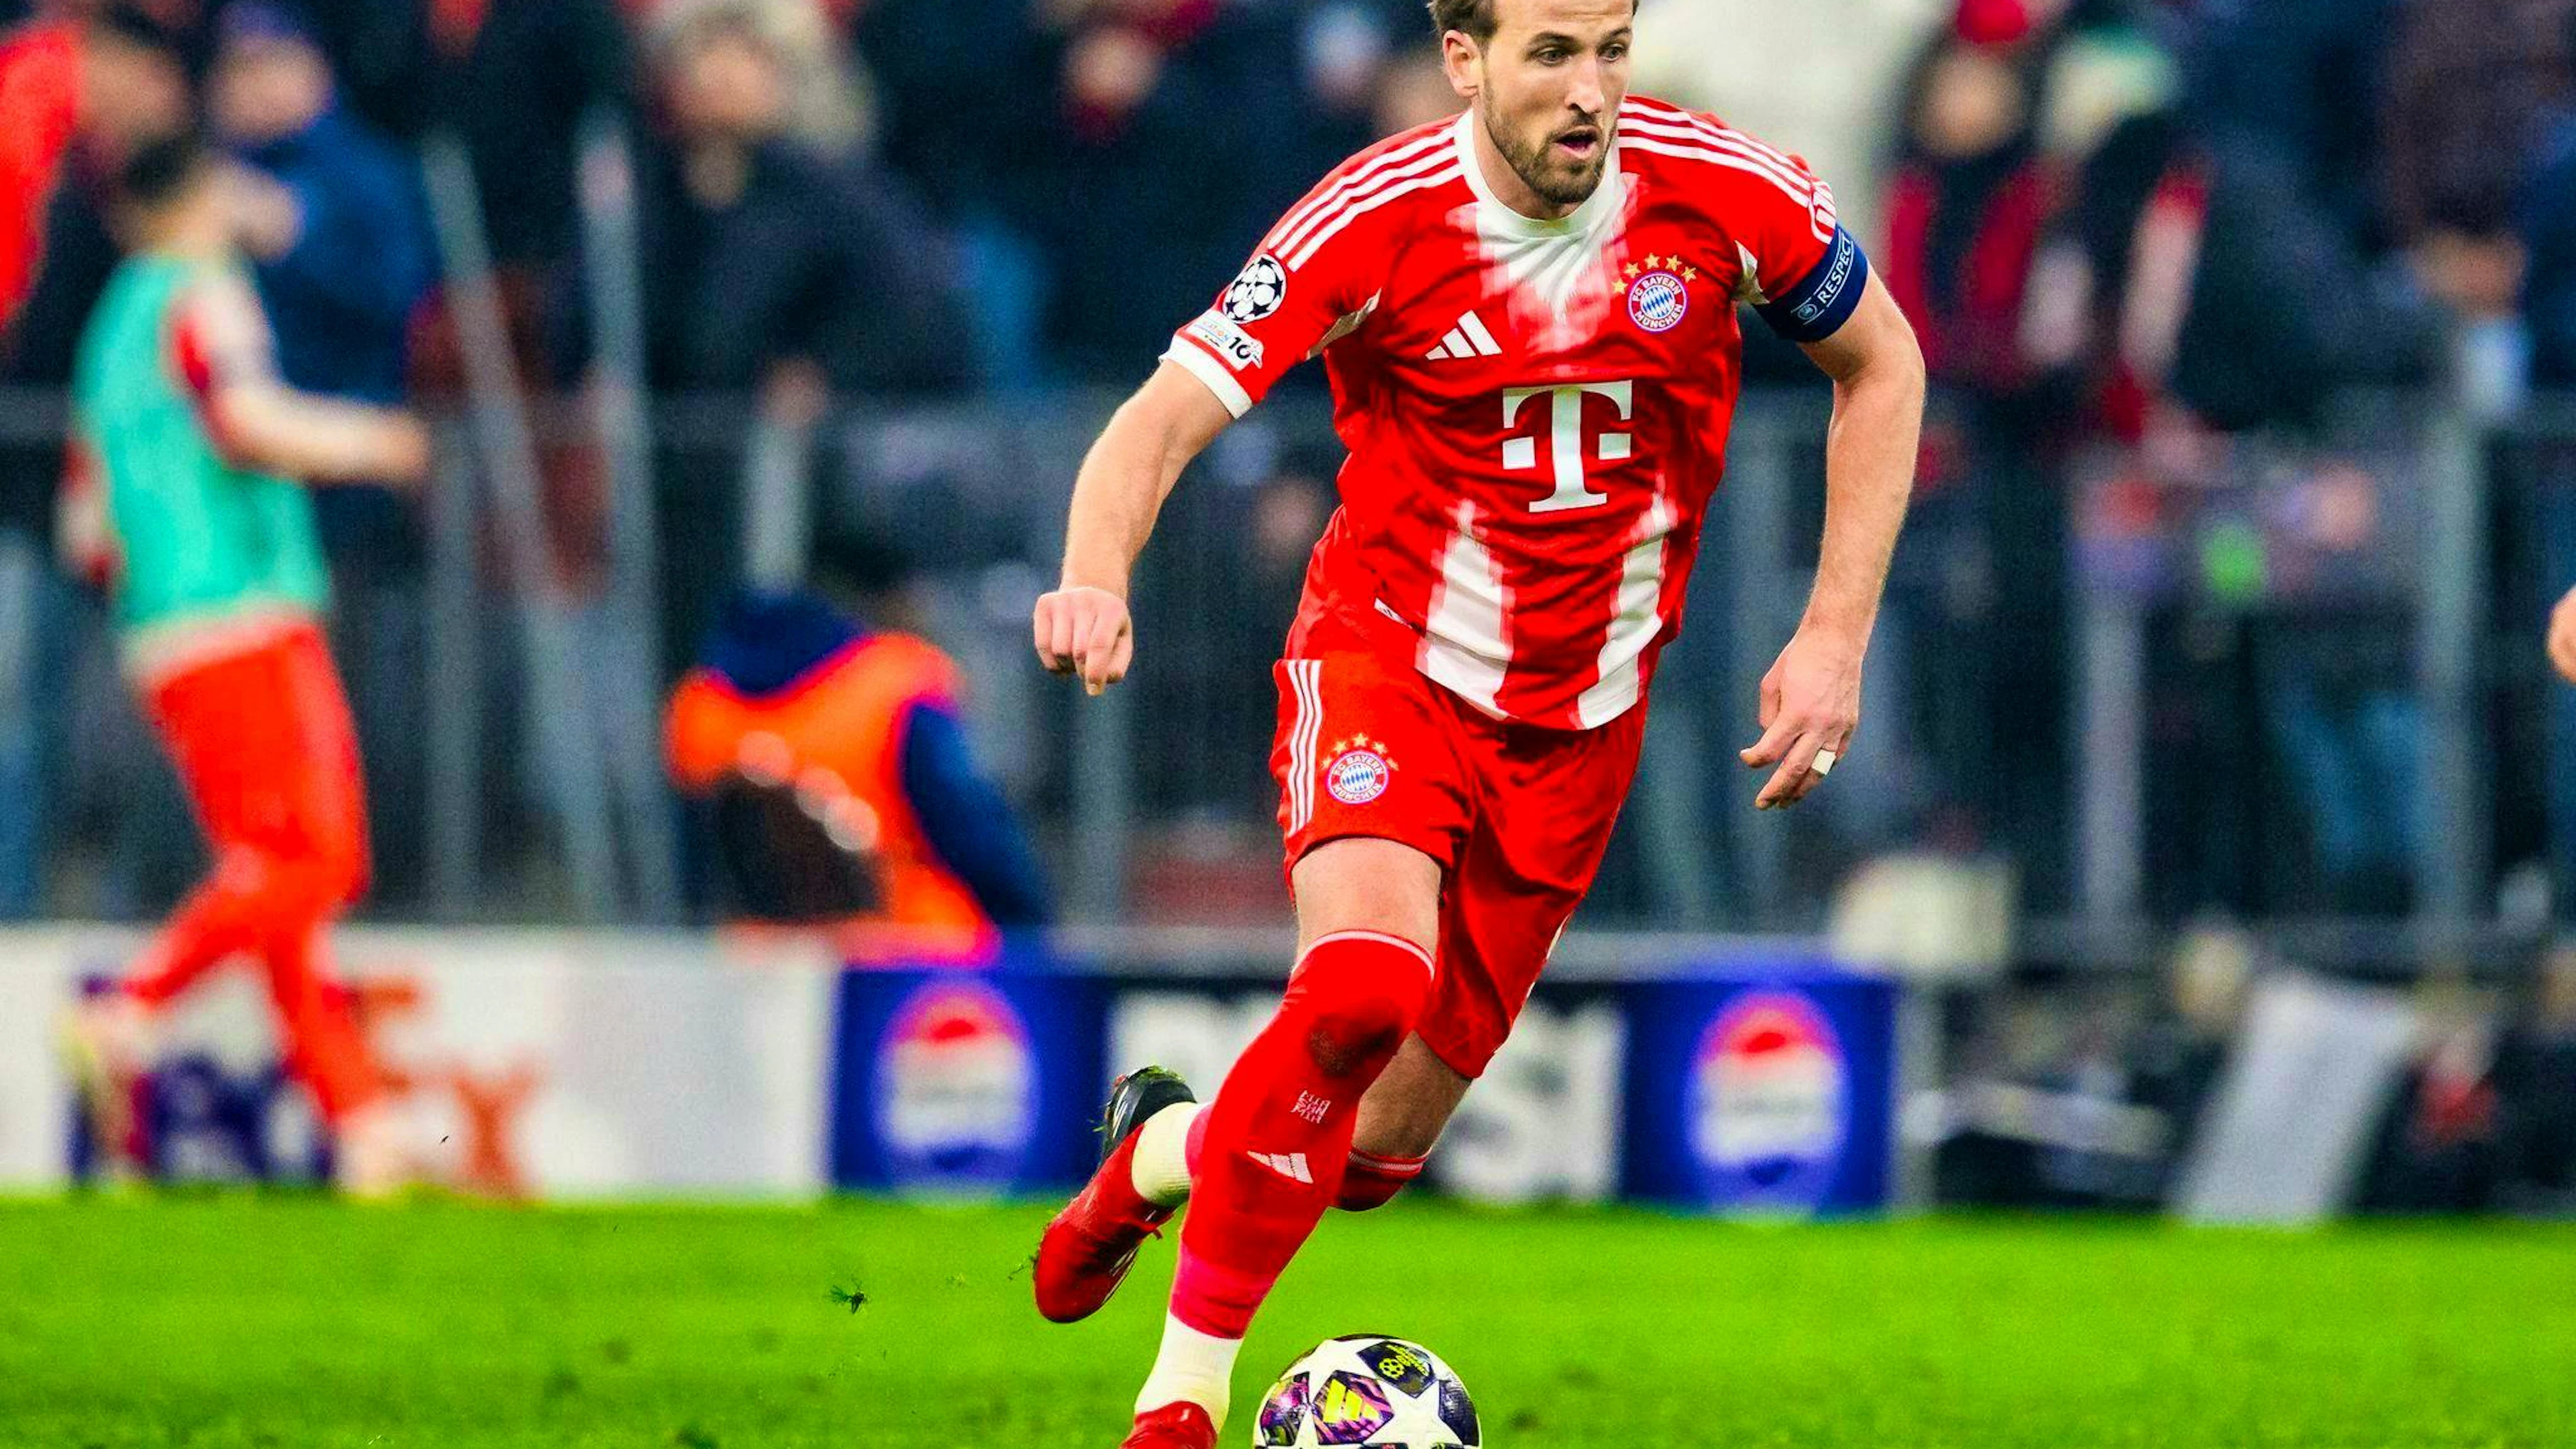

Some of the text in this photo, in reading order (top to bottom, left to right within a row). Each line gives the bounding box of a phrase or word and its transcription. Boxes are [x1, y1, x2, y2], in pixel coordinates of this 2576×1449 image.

[1632, 276, 1682, 302] FC BAYERN
[1817, 232, 1851, 304] RESPECT
[1502, 380, 1633, 513] T
[1346, 755, 1384, 775] BAYERN
